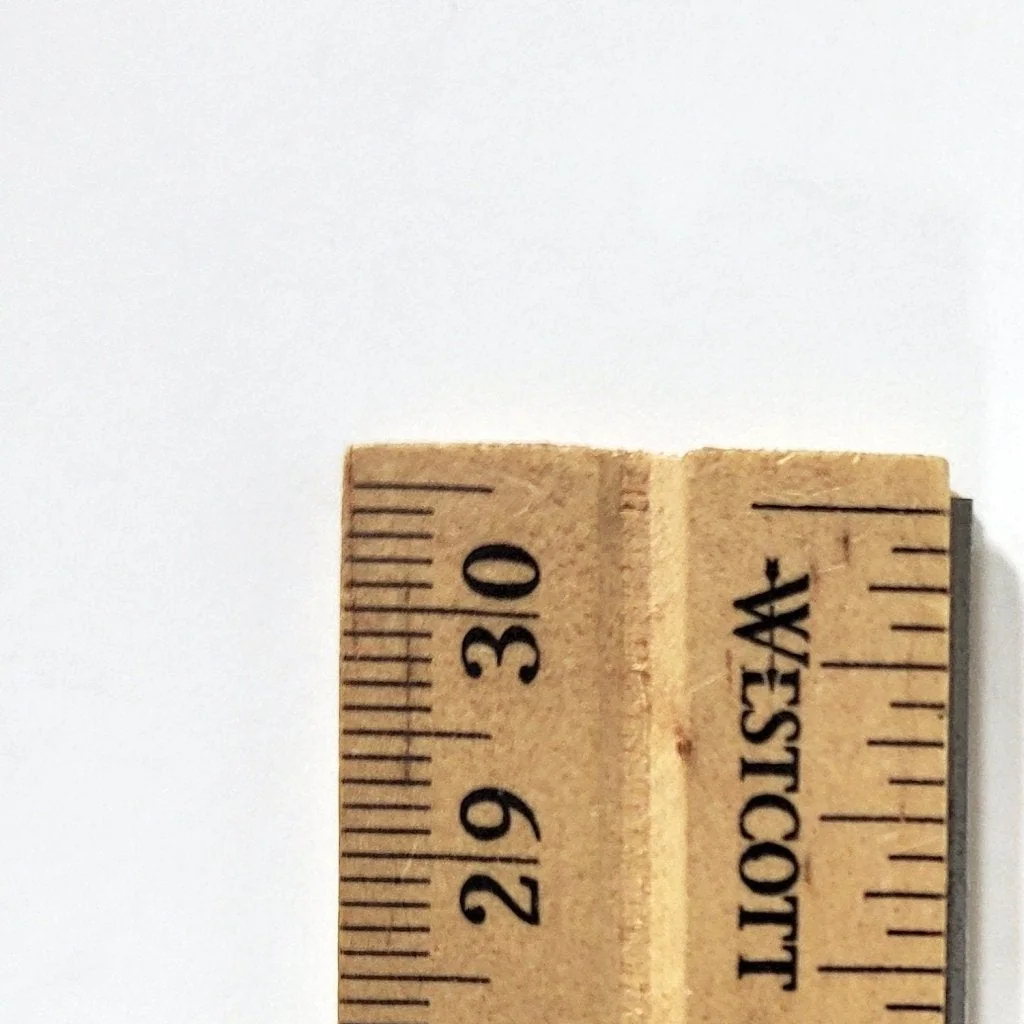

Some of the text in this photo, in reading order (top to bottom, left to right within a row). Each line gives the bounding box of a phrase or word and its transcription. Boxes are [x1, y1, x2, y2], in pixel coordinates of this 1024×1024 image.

[461, 541, 542, 685] 30
[732, 558, 812, 992] WESTCOTT
[458, 786, 541, 927] 29
